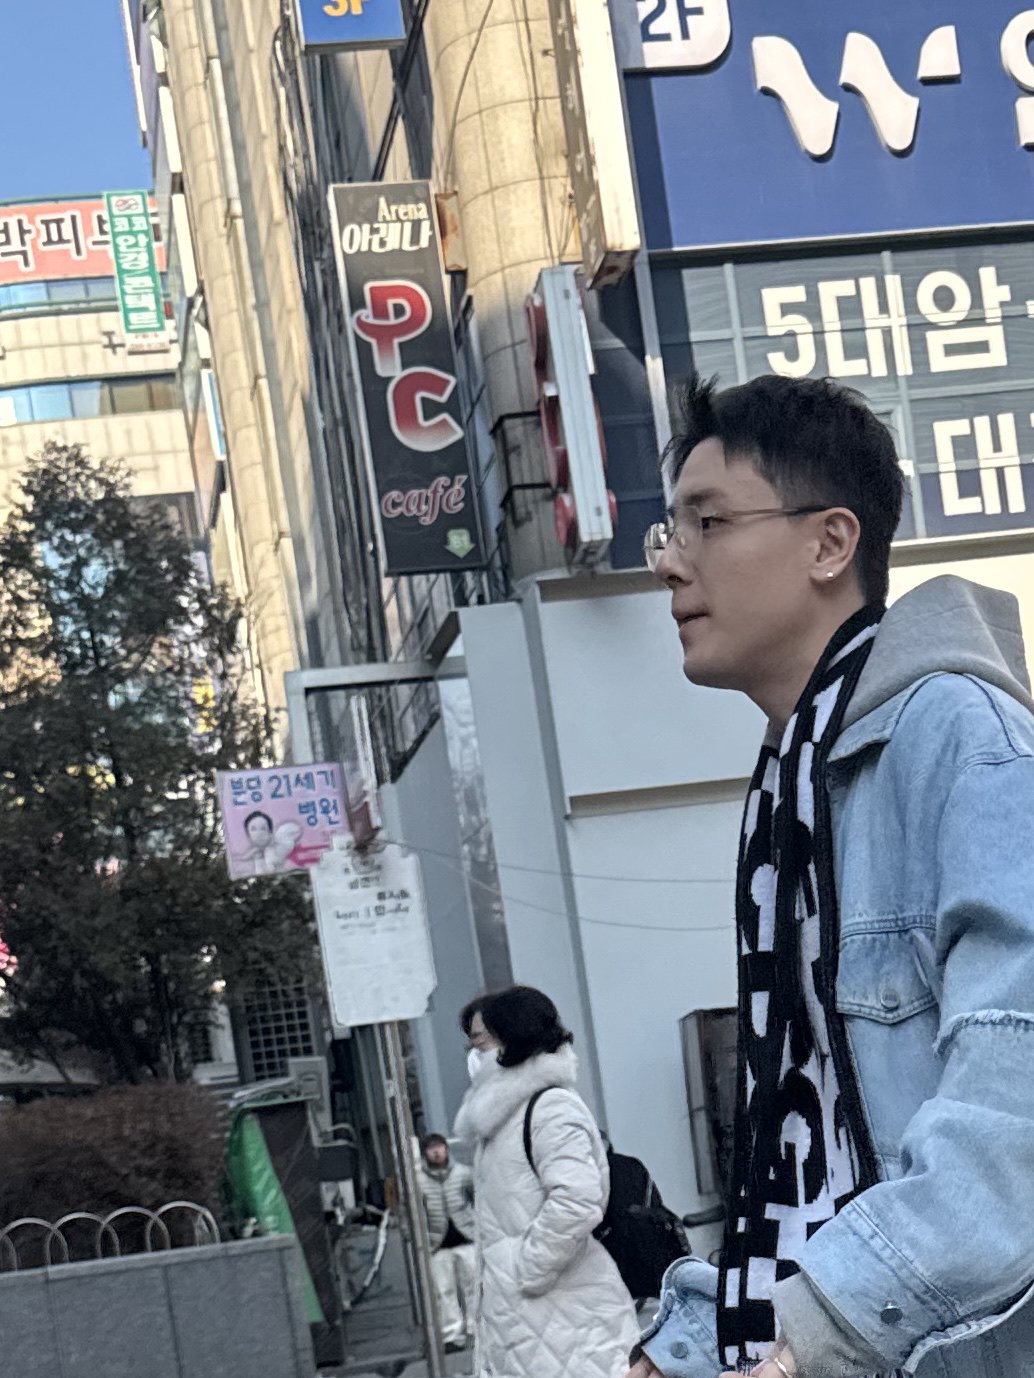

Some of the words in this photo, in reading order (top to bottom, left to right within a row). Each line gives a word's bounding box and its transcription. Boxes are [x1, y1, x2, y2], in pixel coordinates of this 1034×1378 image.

[377, 196, 429, 221] Arena
[342, 220, 432, 254] 아레나
[381, 474, 468, 526] café
[298, 797, 340, 826] 병원
